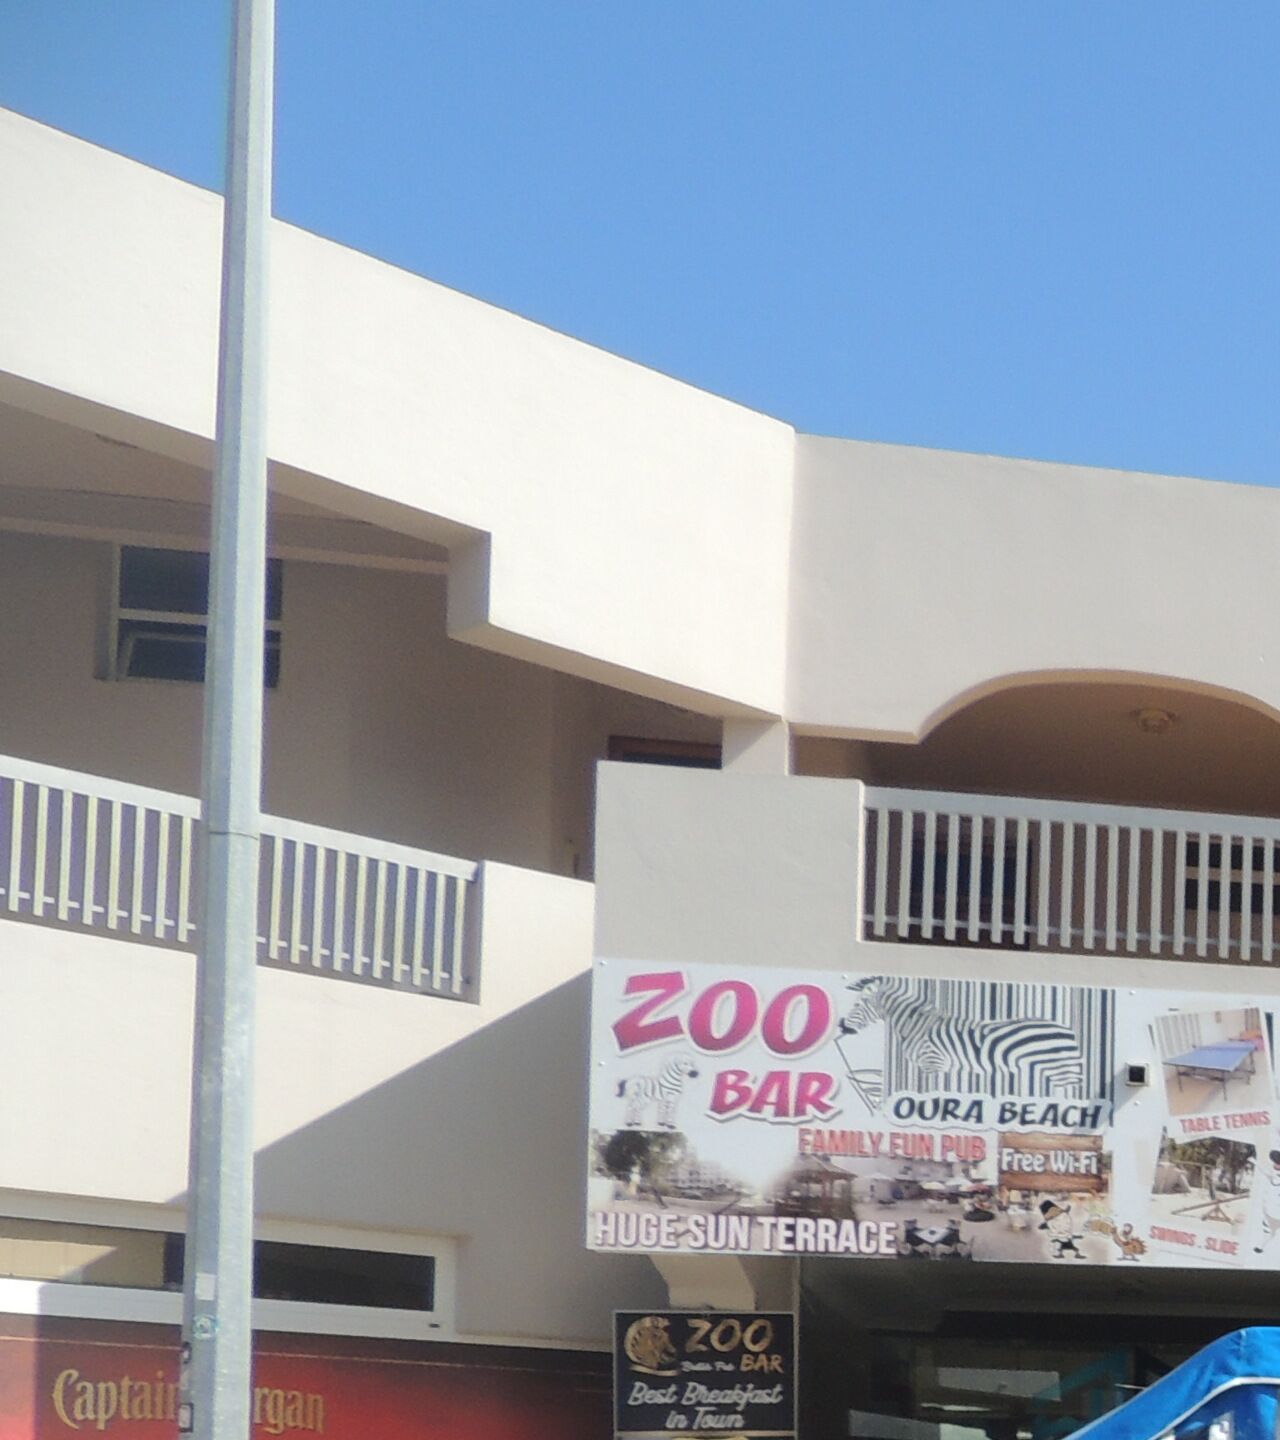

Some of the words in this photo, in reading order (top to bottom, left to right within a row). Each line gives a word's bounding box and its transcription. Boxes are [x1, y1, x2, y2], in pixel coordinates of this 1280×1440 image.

[611, 970, 831, 1056] ZOO
[709, 1068, 836, 1118] BAR
[893, 1096, 983, 1124] OURA
[998, 1101, 1102, 1129] BEACH
[1180, 1116, 1221, 1134] TABLE
[1224, 1111, 1271, 1129] TENNIS
[799, 1127, 884, 1158] FAMILY
[889, 1132, 934, 1159] FUN
[940, 1134, 987, 1161] PUB
[1001, 1148, 1044, 1173] Free
[1050, 1150, 1098, 1174] Wi-Fi
[596, 1211, 677, 1248] HUGE
[687, 1213, 750, 1250] SUN
[758, 1215, 898, 1256] TERRACE
[686, 1318, 774, 1353] ZOO
[739, 1354, 784, 1374] BAR
[52, 1369, 178, 1431] Captai
[253, 1386, 325, 1434] rgan
[628, 1381, 677, 1406] Best
[681, 1381, 783, 1411] Breakfast
[665, 1410, 688, 1429] in
[693, 1407, 744, 1430] Town
